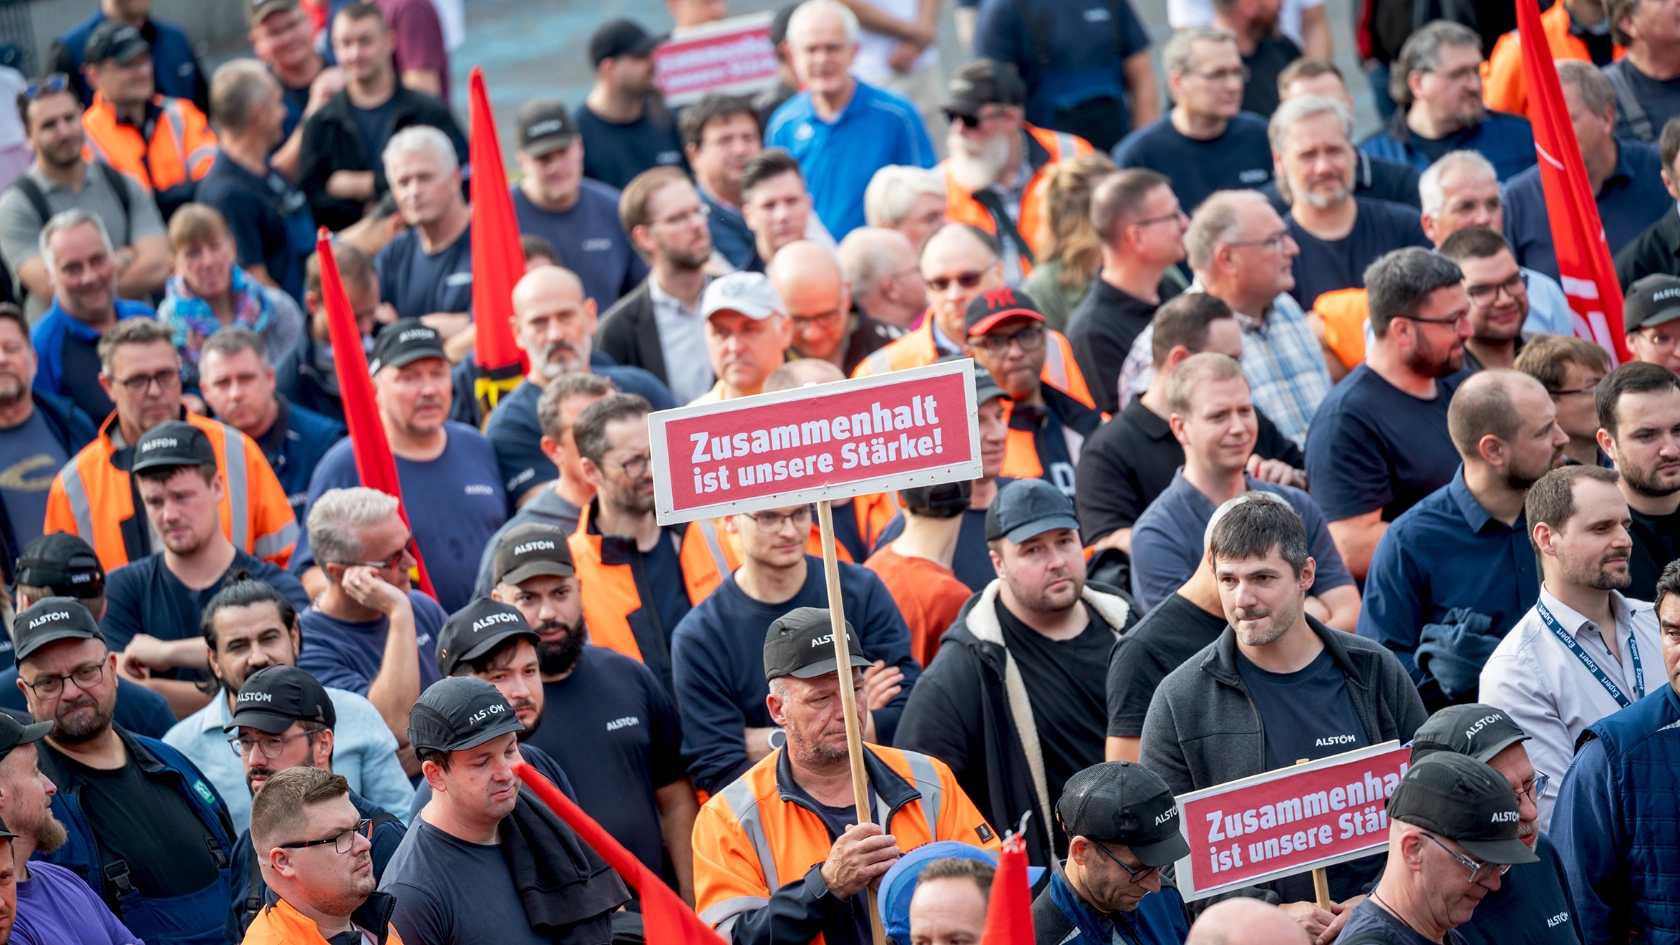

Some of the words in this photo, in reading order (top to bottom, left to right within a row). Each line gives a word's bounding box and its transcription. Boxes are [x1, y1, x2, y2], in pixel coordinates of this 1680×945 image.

[1653, 288, 1680, 302] ALSTO
[690, 394, 939, 464] Zusammenhalt
[142, 437, 178, 453] ALSTOM
[694, 467, 731, 494] ist
[738, 451, 834, 487] unsere
[841, 427, 944, 470] Stärke!
[514, 540, 555, 556] ALSTOM
[29, 611, 70, 630] ALSTOM
[472, 613, 519, 632] ALSTOM
[1579, 651, 1599, 673] Expert
[236, 692, 273, 703] ALSTOM
[1601, 676, 1621, 699] Expert
[469, 704, 506, 726] ALSTOM
[606, 716, 640, 731] ALSTOM
[1465, 713, 1503, 740] ALSTOM
[1315, 734, 1356, 747] ALSTOM
[1206, 762, 1409, 843] Zusammenha
[1155, 804, 1179, 826] ALSTO
[1209, 843, 1243, 873] ist
[1248, 824, 1334, 863] unsere
[1338, 805, 1388, 840] Stär
